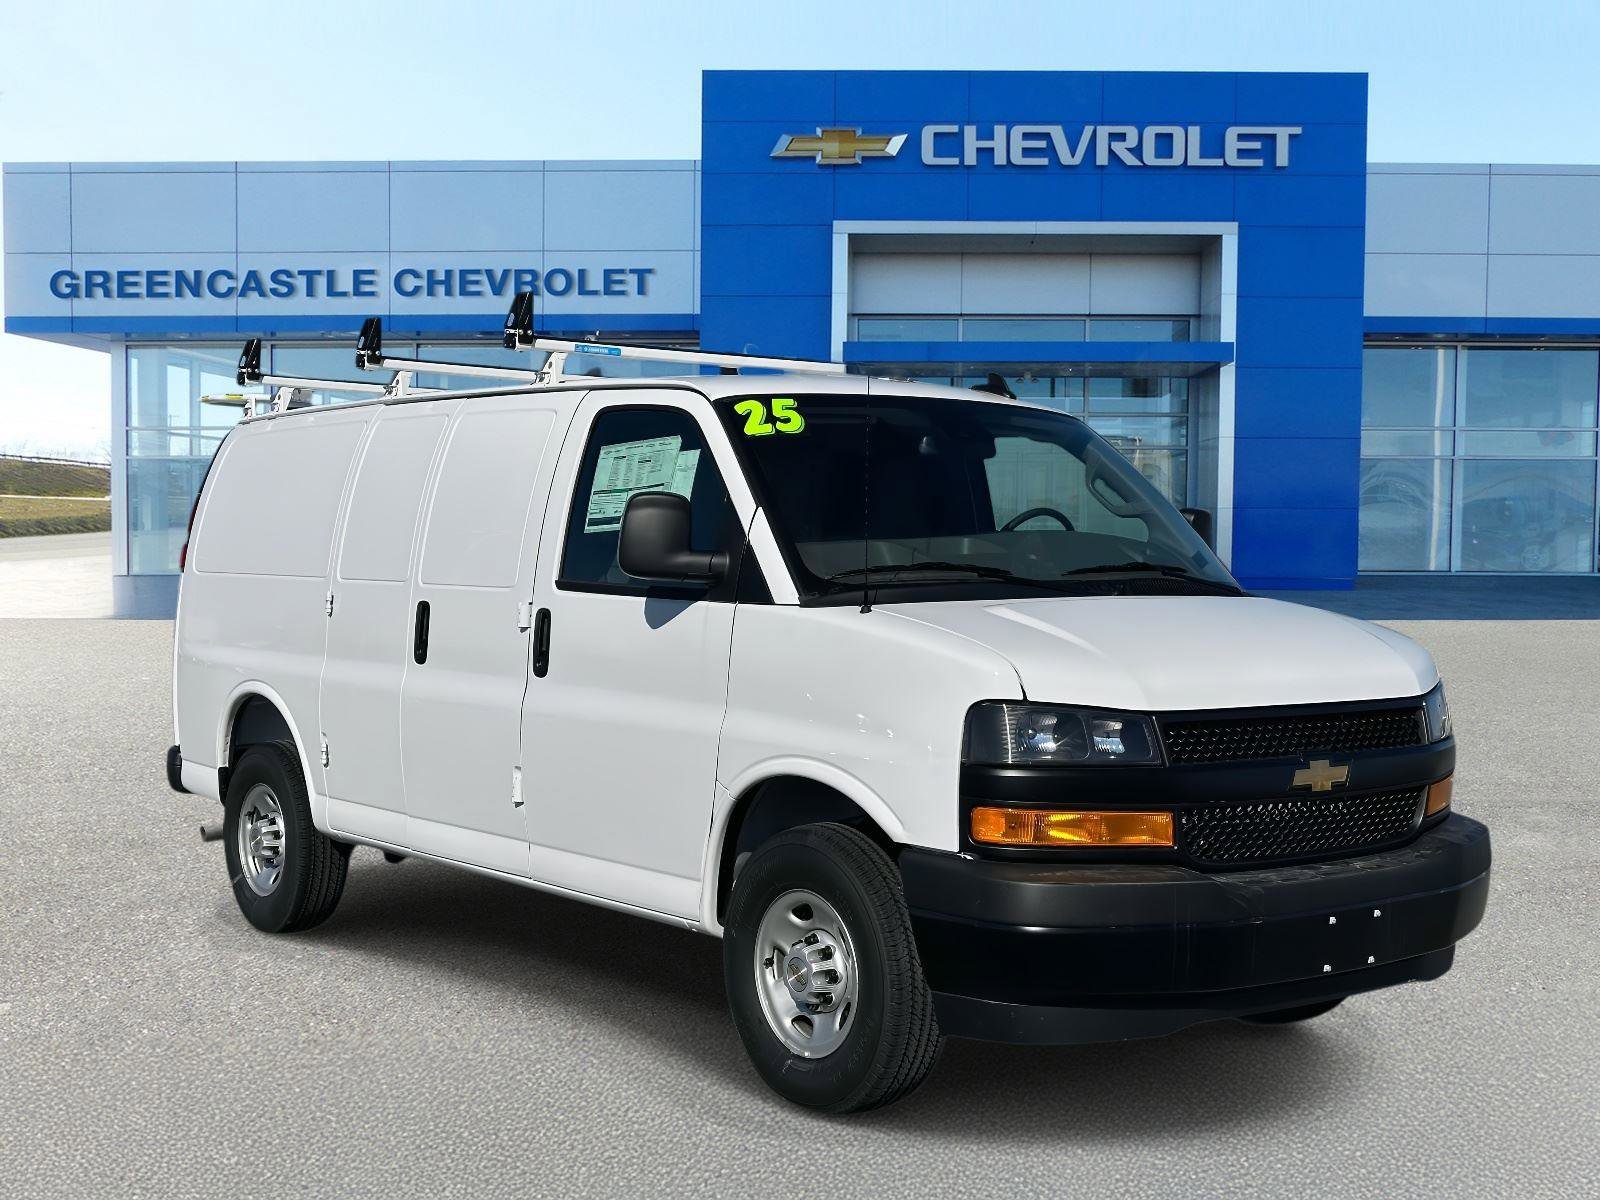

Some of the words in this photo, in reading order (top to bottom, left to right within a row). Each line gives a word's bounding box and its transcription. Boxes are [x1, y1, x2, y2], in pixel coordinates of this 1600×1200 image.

[920, 124, 1303, 167] CHEVROLET
[50, 268, 377, 299] GREENCASTLE
[393, 268, 655, 298] CHEVROLET
[733, 398, 806, 436] 25
